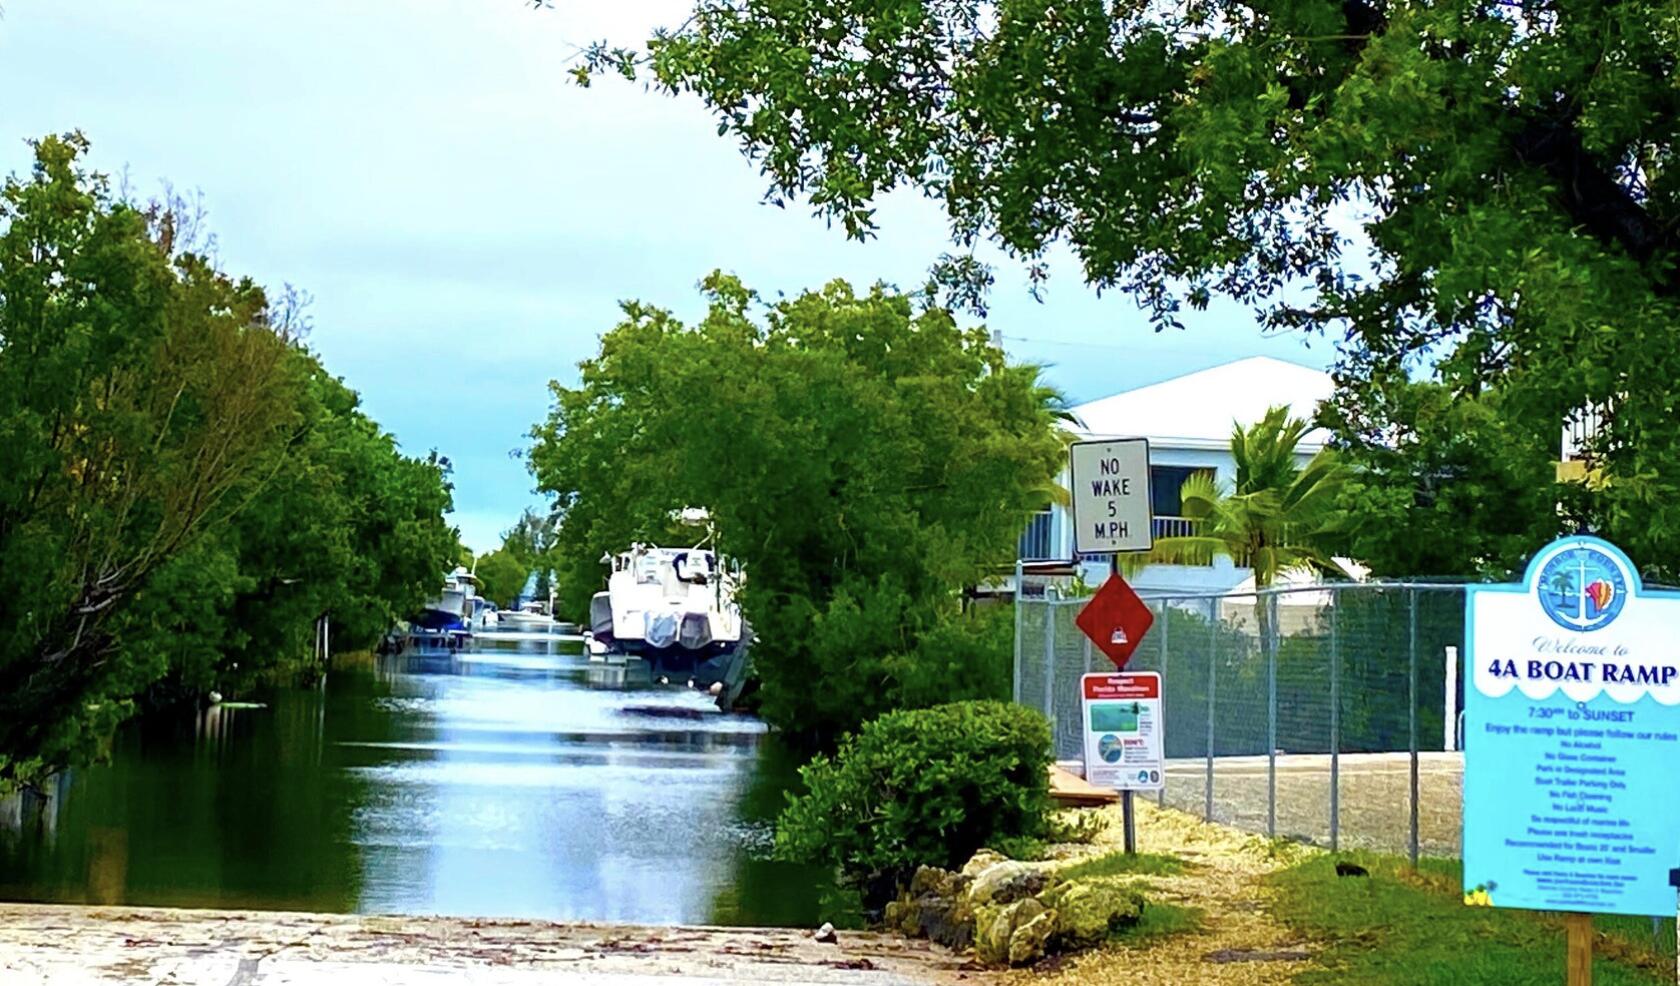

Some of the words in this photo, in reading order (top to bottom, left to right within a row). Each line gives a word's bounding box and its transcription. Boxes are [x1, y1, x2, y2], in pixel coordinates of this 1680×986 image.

[1101, 458, 1119, 475] NO
[1092, 479, 1130, 497] WAKE
[1108, 501, 1116, 517] 5
[1532, 636, 1607, 656] Welcome
[1613, 644, 1630, 656] to
[1488, 659, 1519, 678] 4A
[1527, 660, 1596, 682] BOAT
[1602, 663, 1677, 685] RAMP
[1568, 709, 1580, 720] to
[1584, 709, 1635, 723] SUNSET
[1486, 722, 1511, 734] Enjoy
[1513, 724, 1527, 734] the
[1532, 728, 1554, 737] ramp
[1557, 726, 1572, 736] but
[1574, 727, 1604, 738] please
[1606, 729, 1634, 739] follow
[1654, 731, 1677, 741] rules
[1561, 740, 1572, 748] No
[1574, 741, 1602, 749] Alcohol
[1536, 764, 1553, 772] Park
[1609, 768, 1625, 776] Area
[1536, 777, 1553, 785] Boat
[1586, 805, 1608, 813] Music
